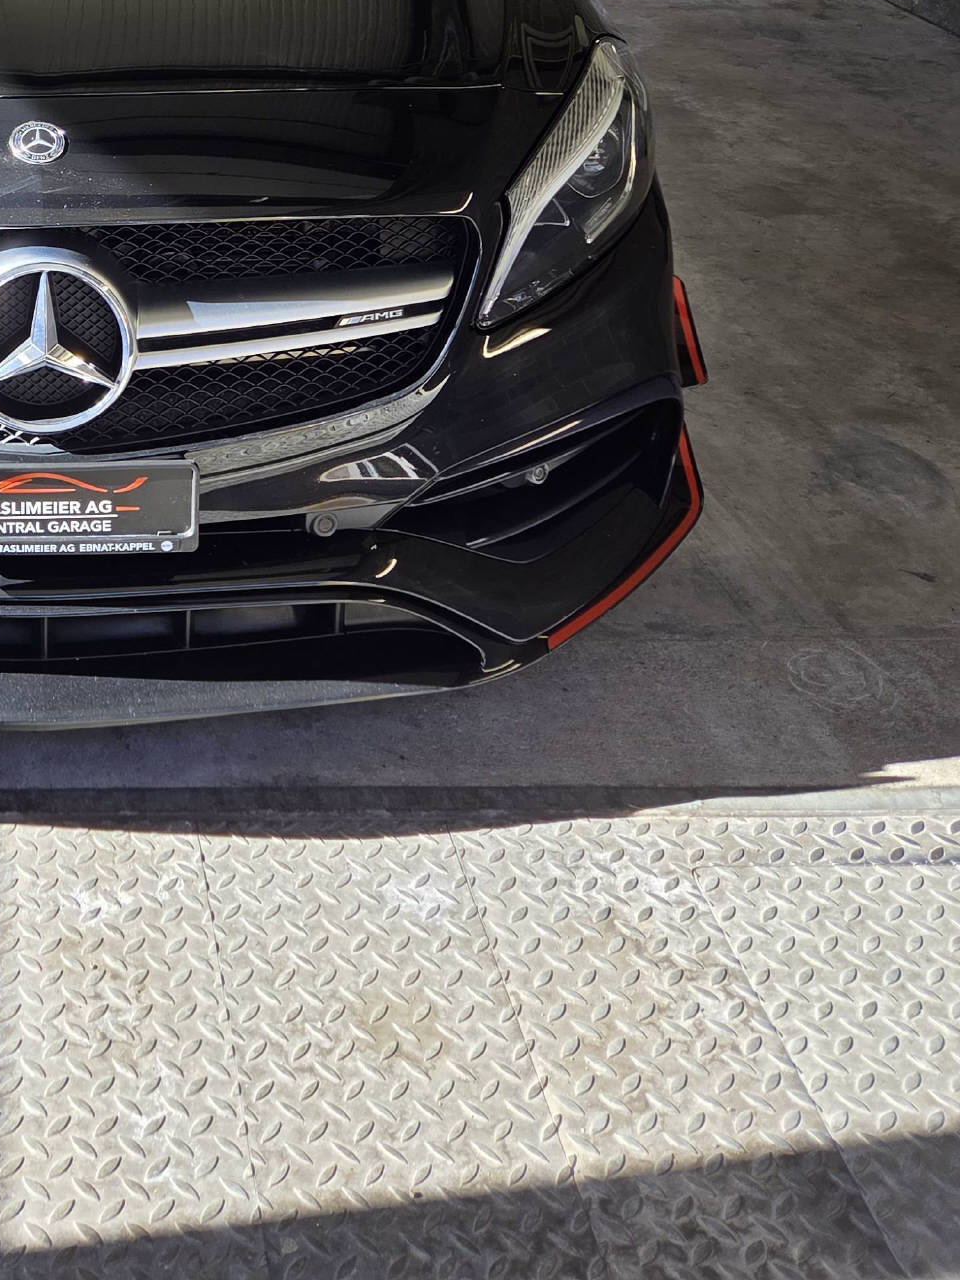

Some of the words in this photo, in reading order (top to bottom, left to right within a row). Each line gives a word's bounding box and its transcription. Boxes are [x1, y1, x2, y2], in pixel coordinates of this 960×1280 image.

[360, 309, 403, 323] AMG
[85, 499, 113, 514] AG
[47, 520, 112, 533] GARAGE
[59, 543, 76, 552] AG
[79, 542, 156, 552] EBNAT-KAPPEL
